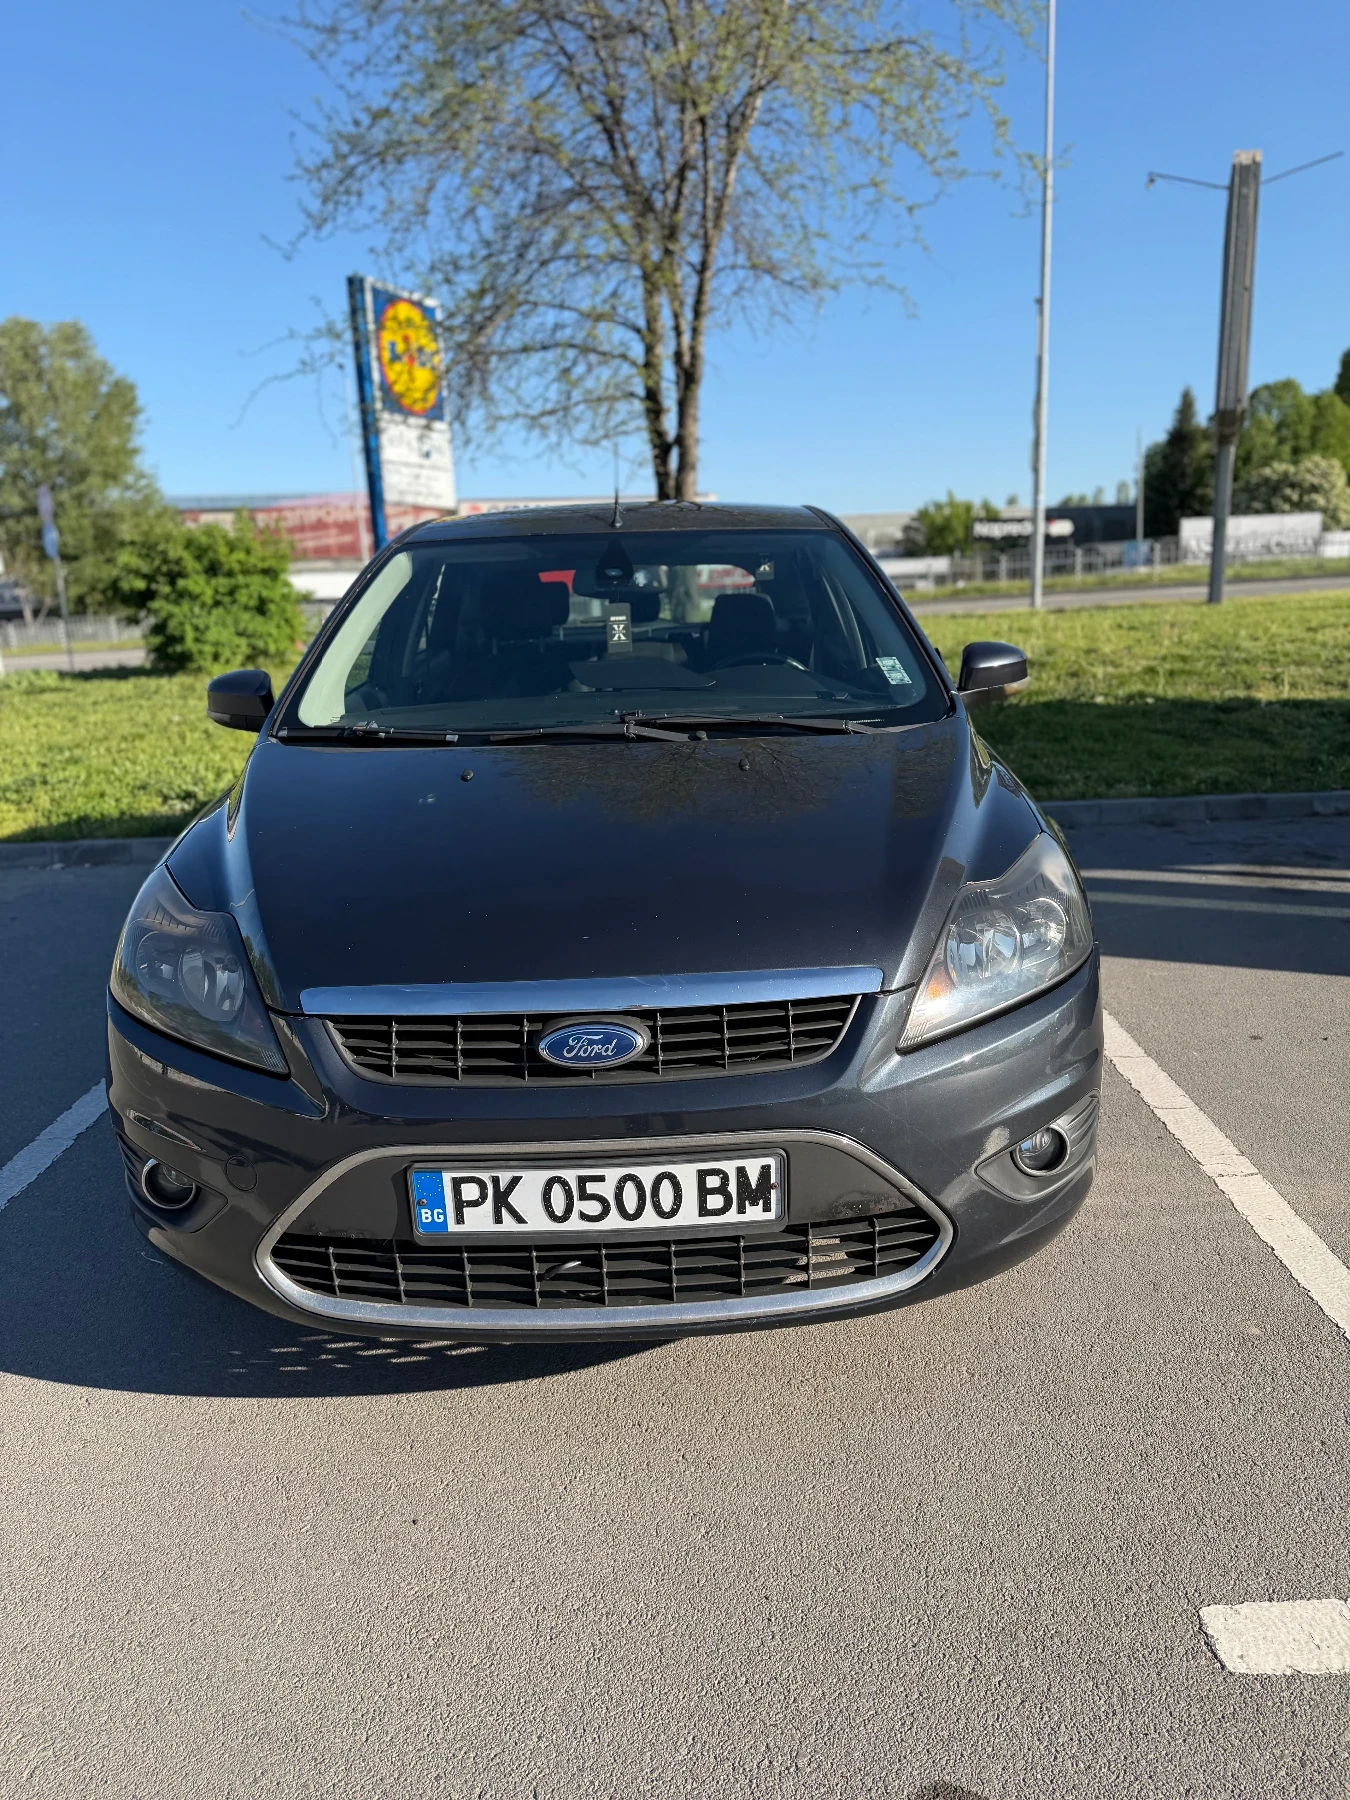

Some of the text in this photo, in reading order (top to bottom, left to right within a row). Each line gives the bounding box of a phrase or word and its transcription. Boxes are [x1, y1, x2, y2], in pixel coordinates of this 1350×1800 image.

[563, 1034, 617, 1057] Ford
[451, 1164, 772, 1225] PK 0500 BM
[420, 1208, 444, 1223] BG
